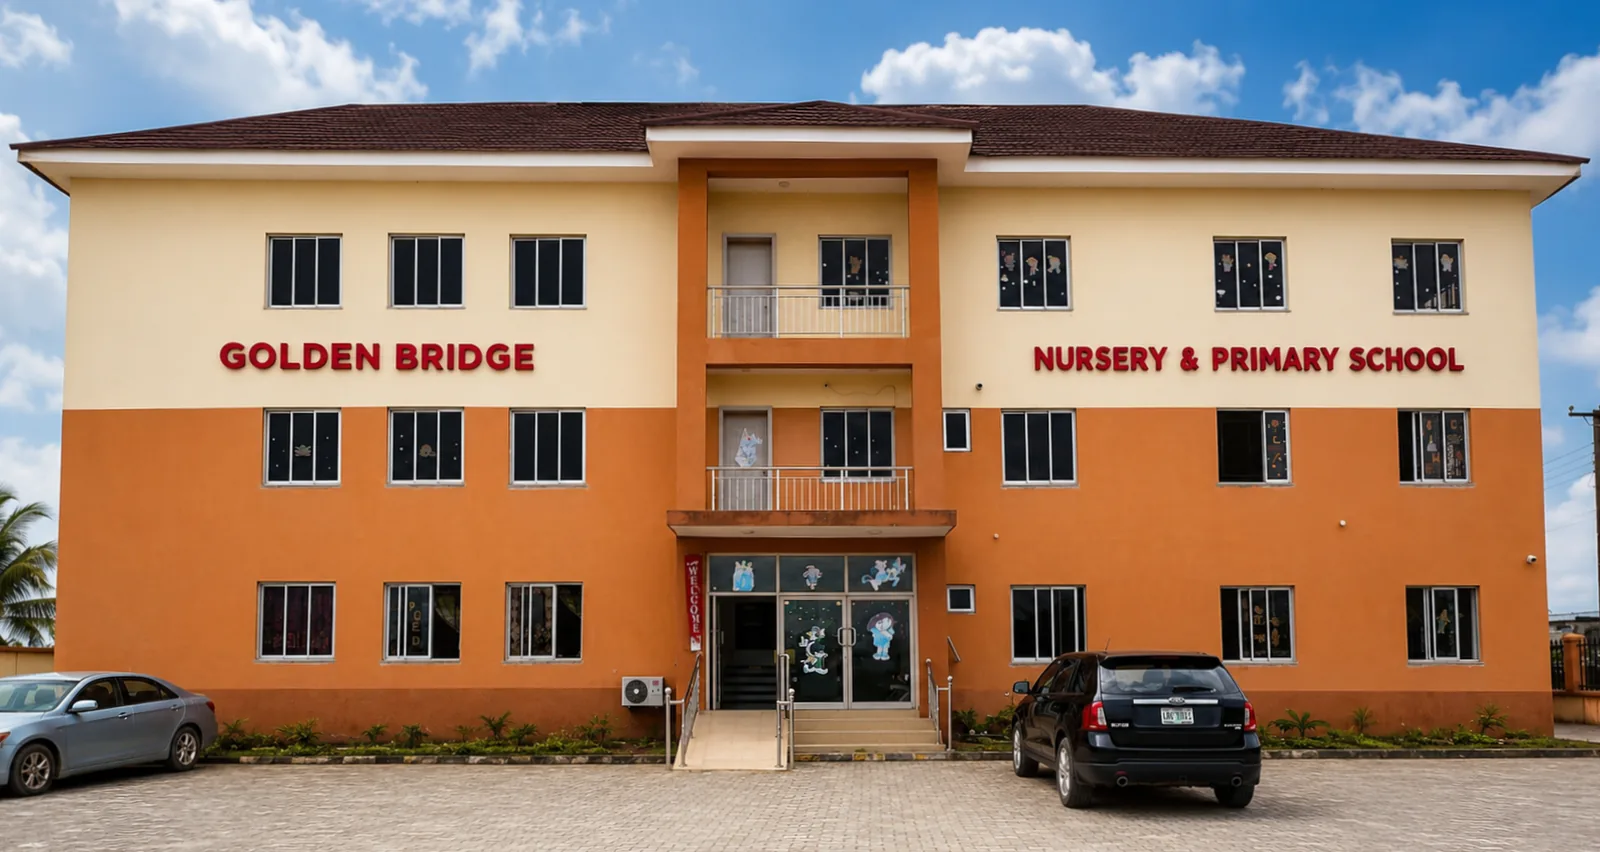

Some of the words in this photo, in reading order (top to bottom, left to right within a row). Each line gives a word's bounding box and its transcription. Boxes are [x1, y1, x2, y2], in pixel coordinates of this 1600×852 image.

[219, 342, 381, 371] GOLDEN
[395, 342, 535, 371] BRIDGE
[1033, 345, 1168, 372] NURSERY
[1179, 346, 1200, 372] &
[1211, 346, 1340, 373] PRIMARY
[1348, 346, 1465, 373] SCHOOL
